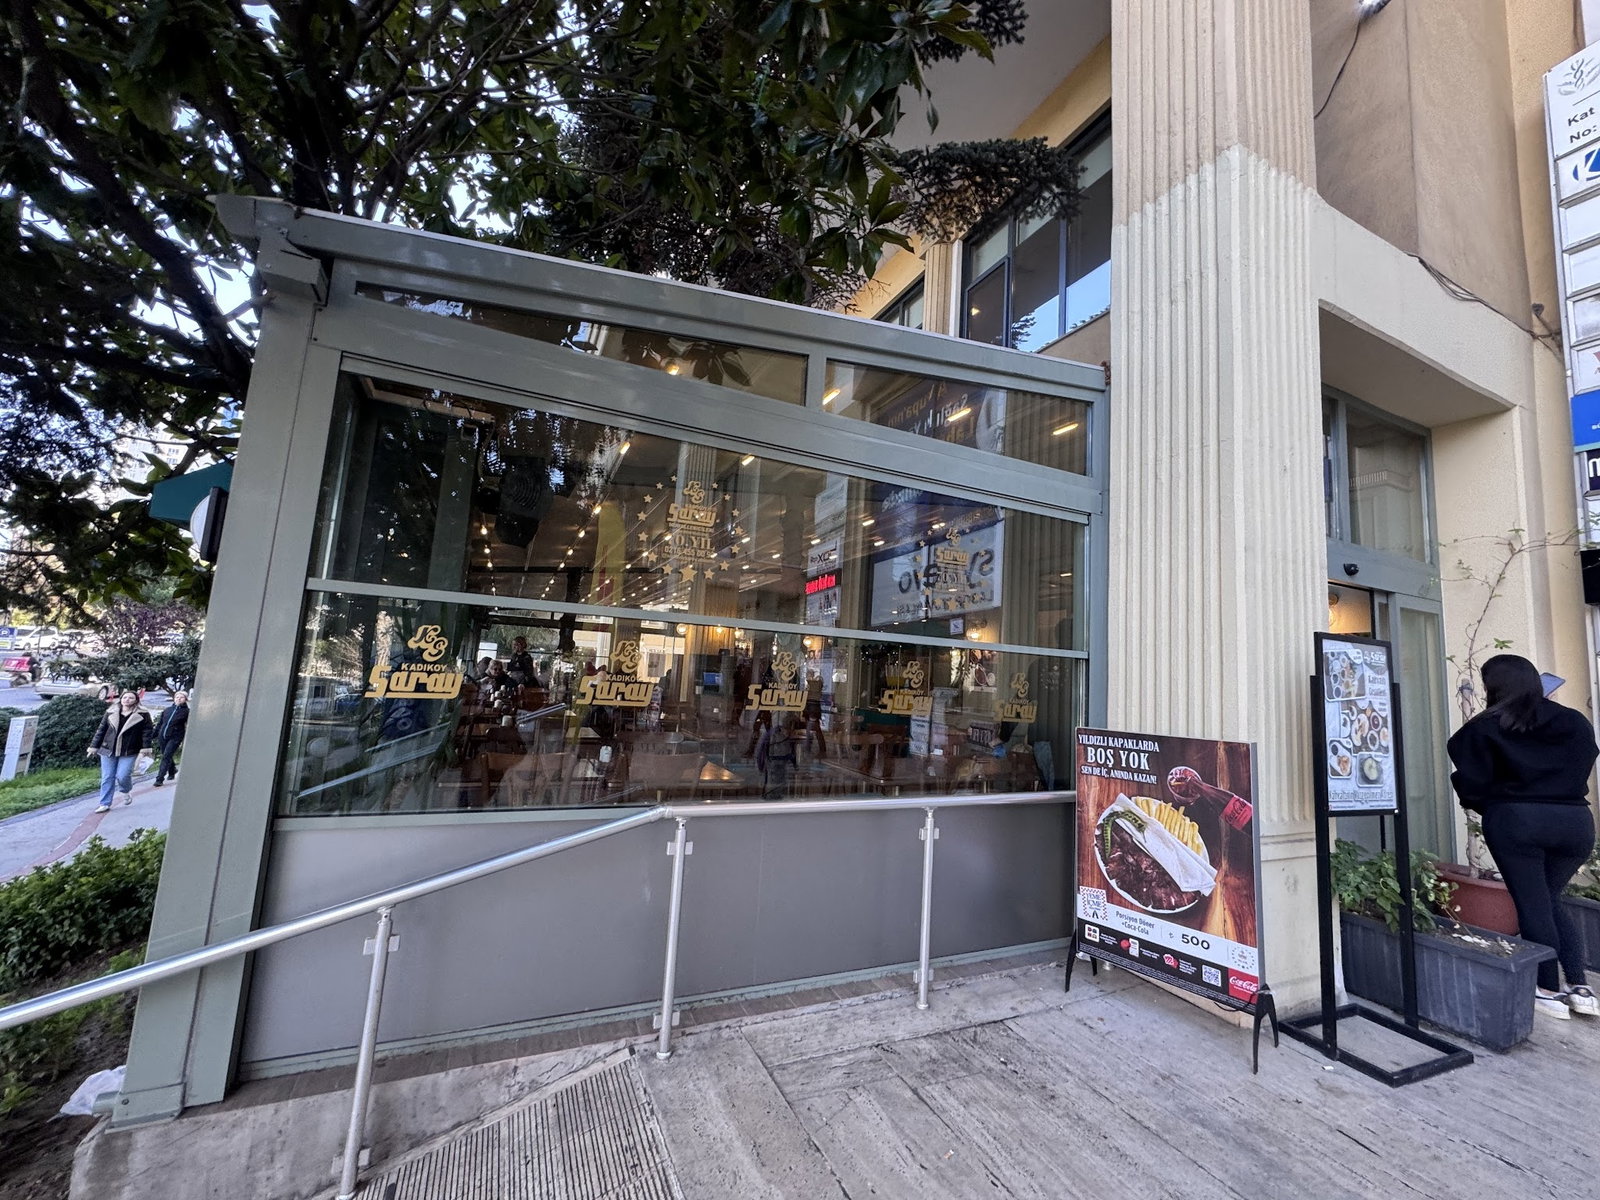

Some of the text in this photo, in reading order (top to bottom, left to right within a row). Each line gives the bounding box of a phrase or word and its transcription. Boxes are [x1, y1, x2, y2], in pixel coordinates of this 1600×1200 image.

[1568, 107, 1595, 126] Kat
[1570, 125, 1597, 143] No:
[364, 664, 464, 700] Saray
[576, 675, 654, 707] Saray
[745, 684, 808, 711] Saray
[1078, 734, 1160, 753] YILDIZLI KAPAKLARDA
[1087, 746, 1150, 771] BOŞ YOK
[1081, 765, 1093, 774] SEN
[1093, 767, 1101, 776] DE
[1110, 769, 1133, 781] ANINDA
[1133, 773, 1157, 785] KAZAN!
[1116, 911, 1155, 929] Porsiyon Döner
[1181, 933, 1211, 950] 500
